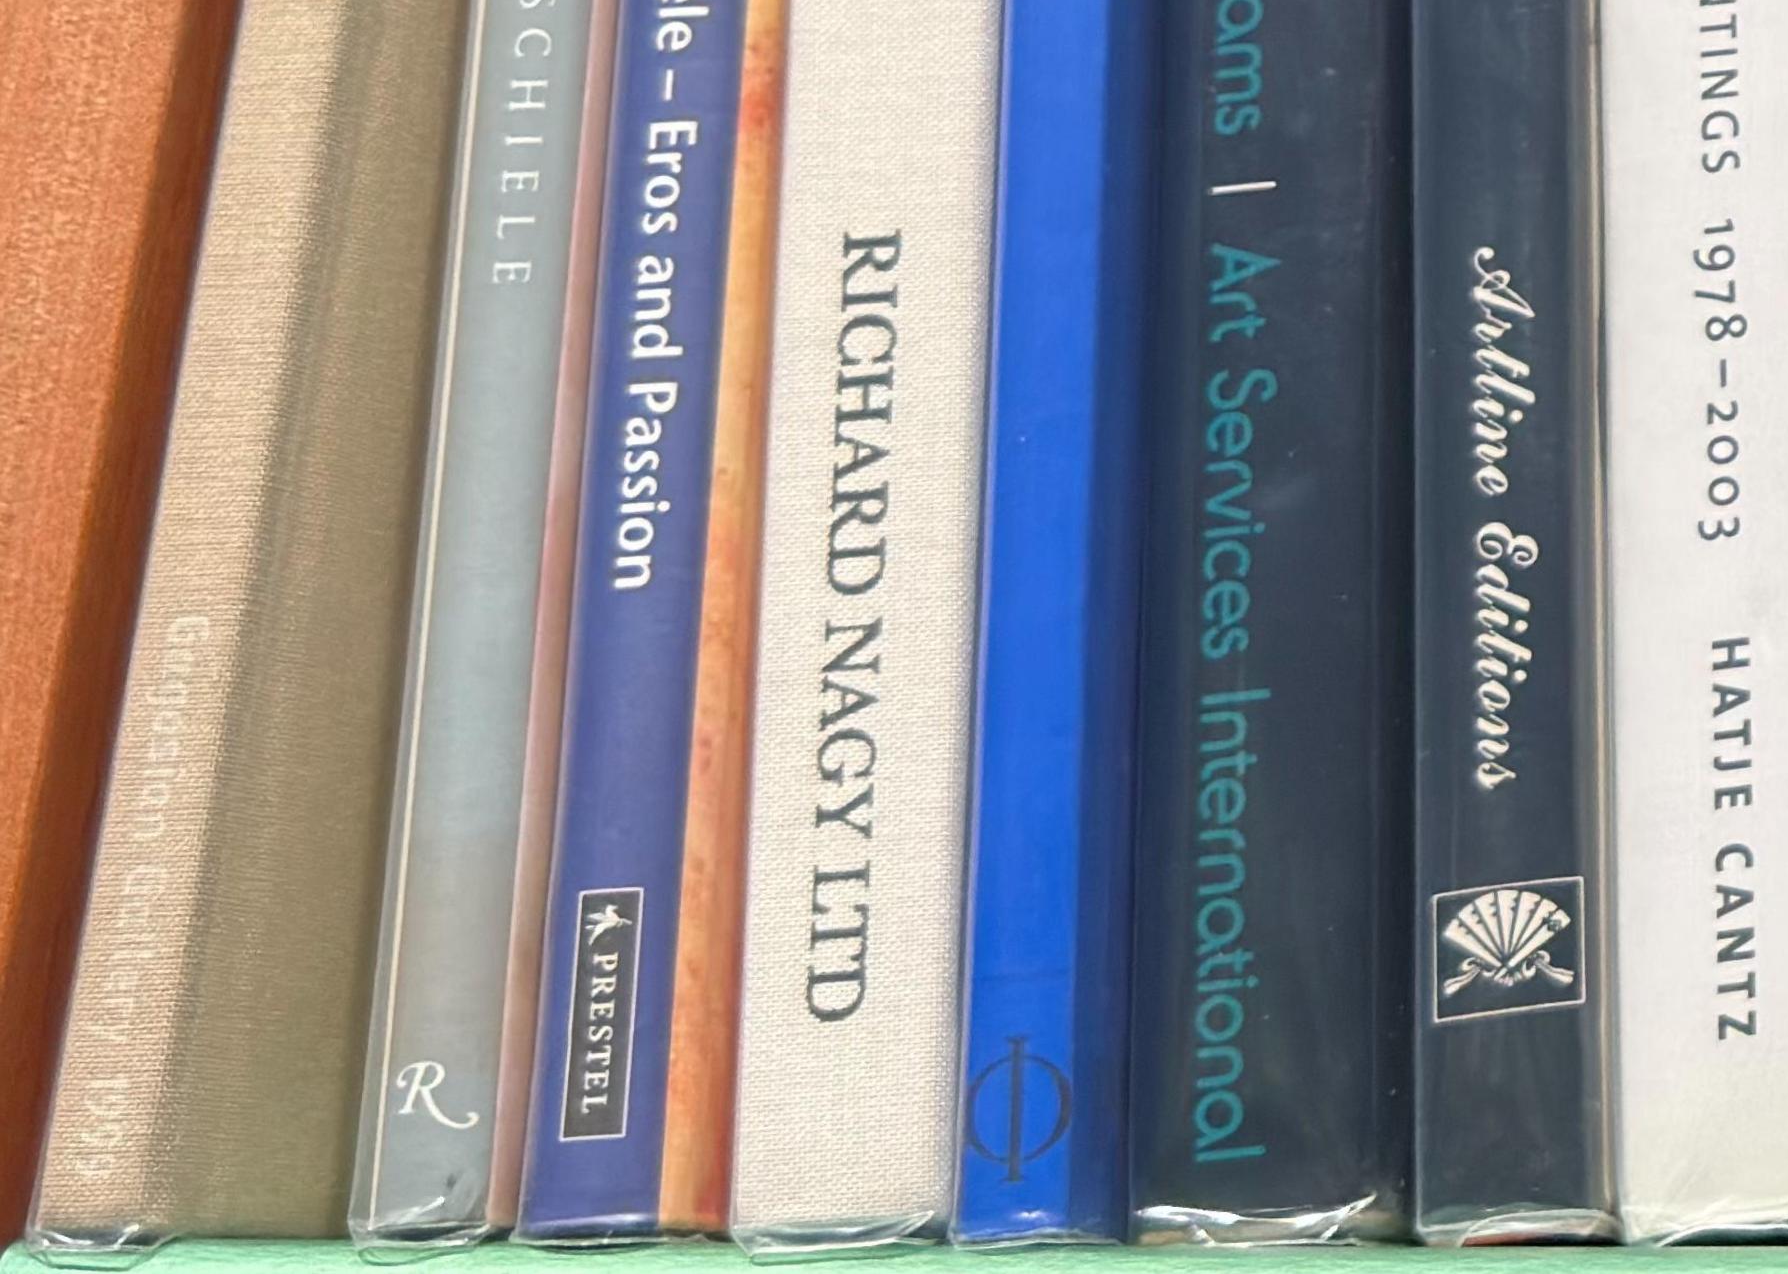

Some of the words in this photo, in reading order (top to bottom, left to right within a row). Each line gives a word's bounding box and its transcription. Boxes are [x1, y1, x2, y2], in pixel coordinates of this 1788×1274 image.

[640, 122, 698, 233] Eros
[631, 255, 682, 356] and
[1208, 244, 1282, 342] Art
[1470, 247, 1536, 496] Artline
[614, 383, 678, 588] Passion
[826, 230, 902, 596] RICHARD
[1202, 369, 1279, 657] Services
[813, 620, 883, 839] NAGY
[1475, 522, 1540, 790] Editions
[1710, 637, 1755, 810] HATJE
[806, 868, 872, 1023] LTD
[1195, 688, 1271, 1163] International
[1714, 843, 1758, 1041] CANTZ
[582, 953, 618, 1114] PRESTEL
